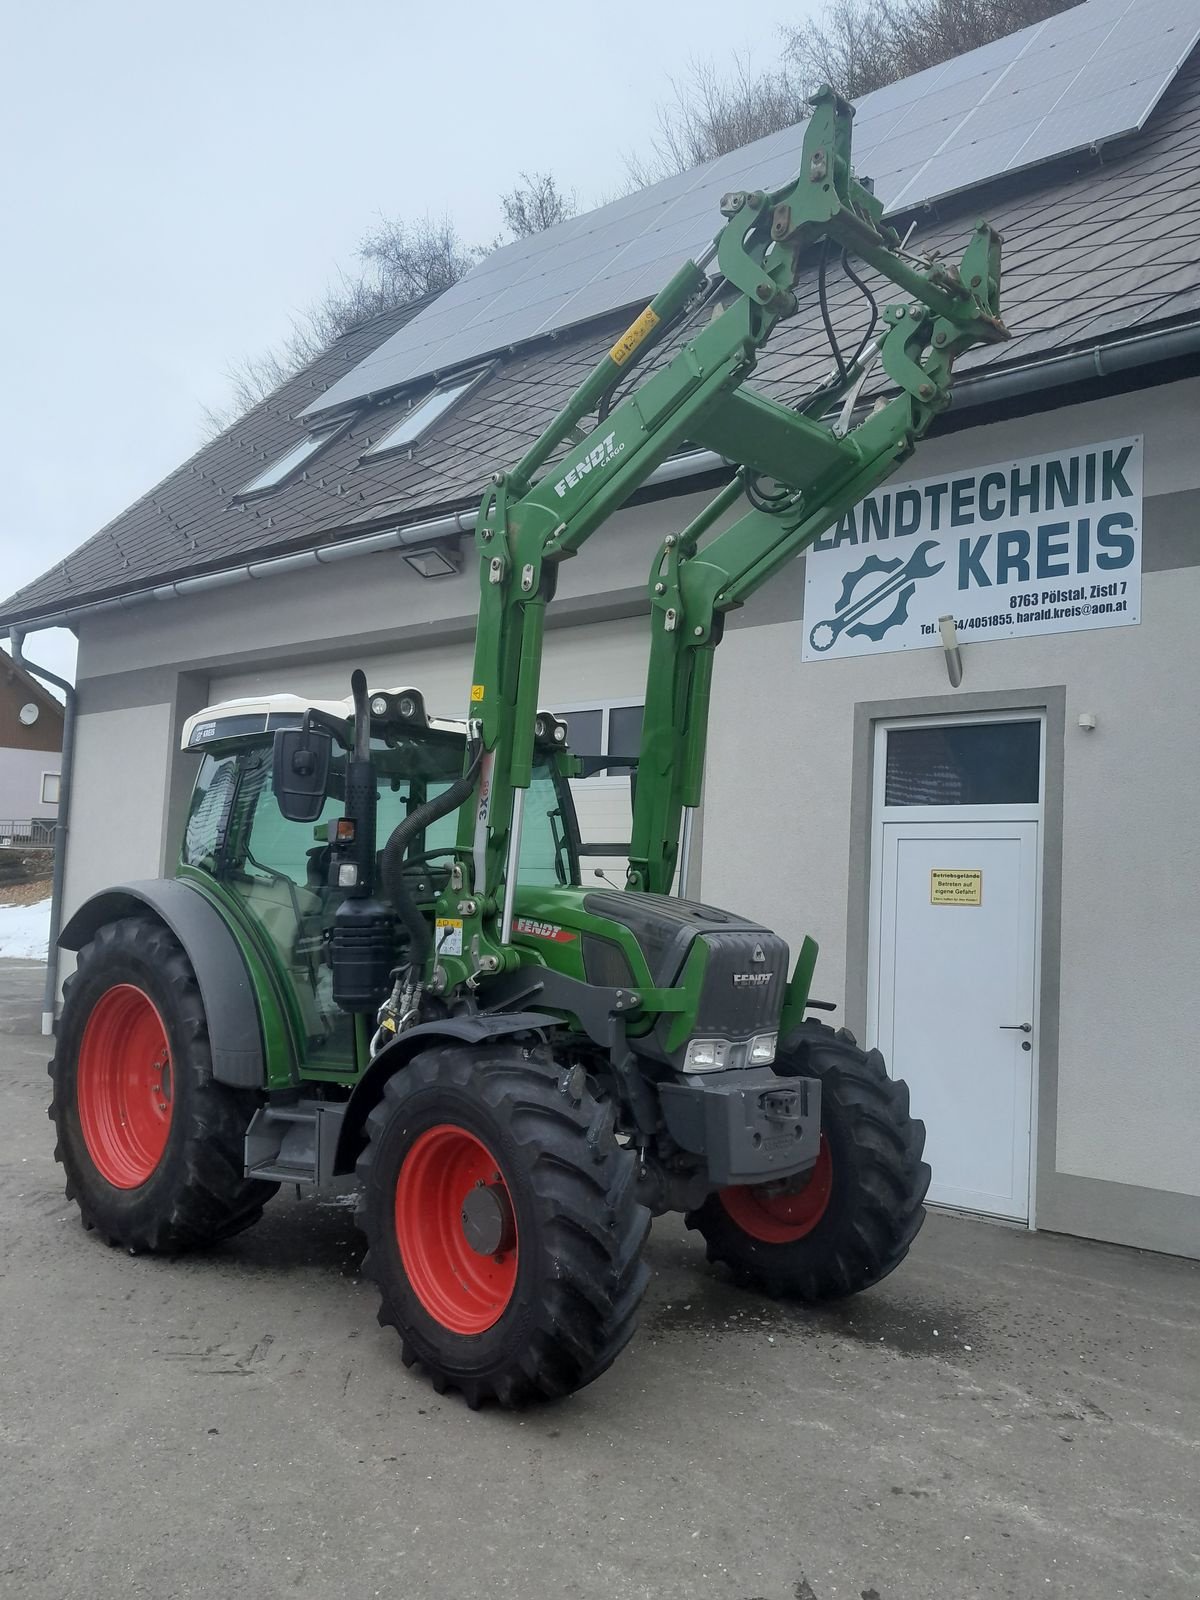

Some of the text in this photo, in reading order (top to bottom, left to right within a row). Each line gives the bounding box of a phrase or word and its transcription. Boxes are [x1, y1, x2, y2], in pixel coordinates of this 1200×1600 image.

[554, 431, 616, 498] FENDT
[600, 442, 625, 467] CARGO
[958, 512, 1136, 590] KREIS
[1009, 581, 1128, 609] 8763 Pölstal, Zistl 7
[920, 623, 937, 635] Tel.
[1016, 600, 1128, 624] harald.kreis@aon.at
[517, 918, 562, 938] FENDT
[733, 973, 773, 985] FENDT
